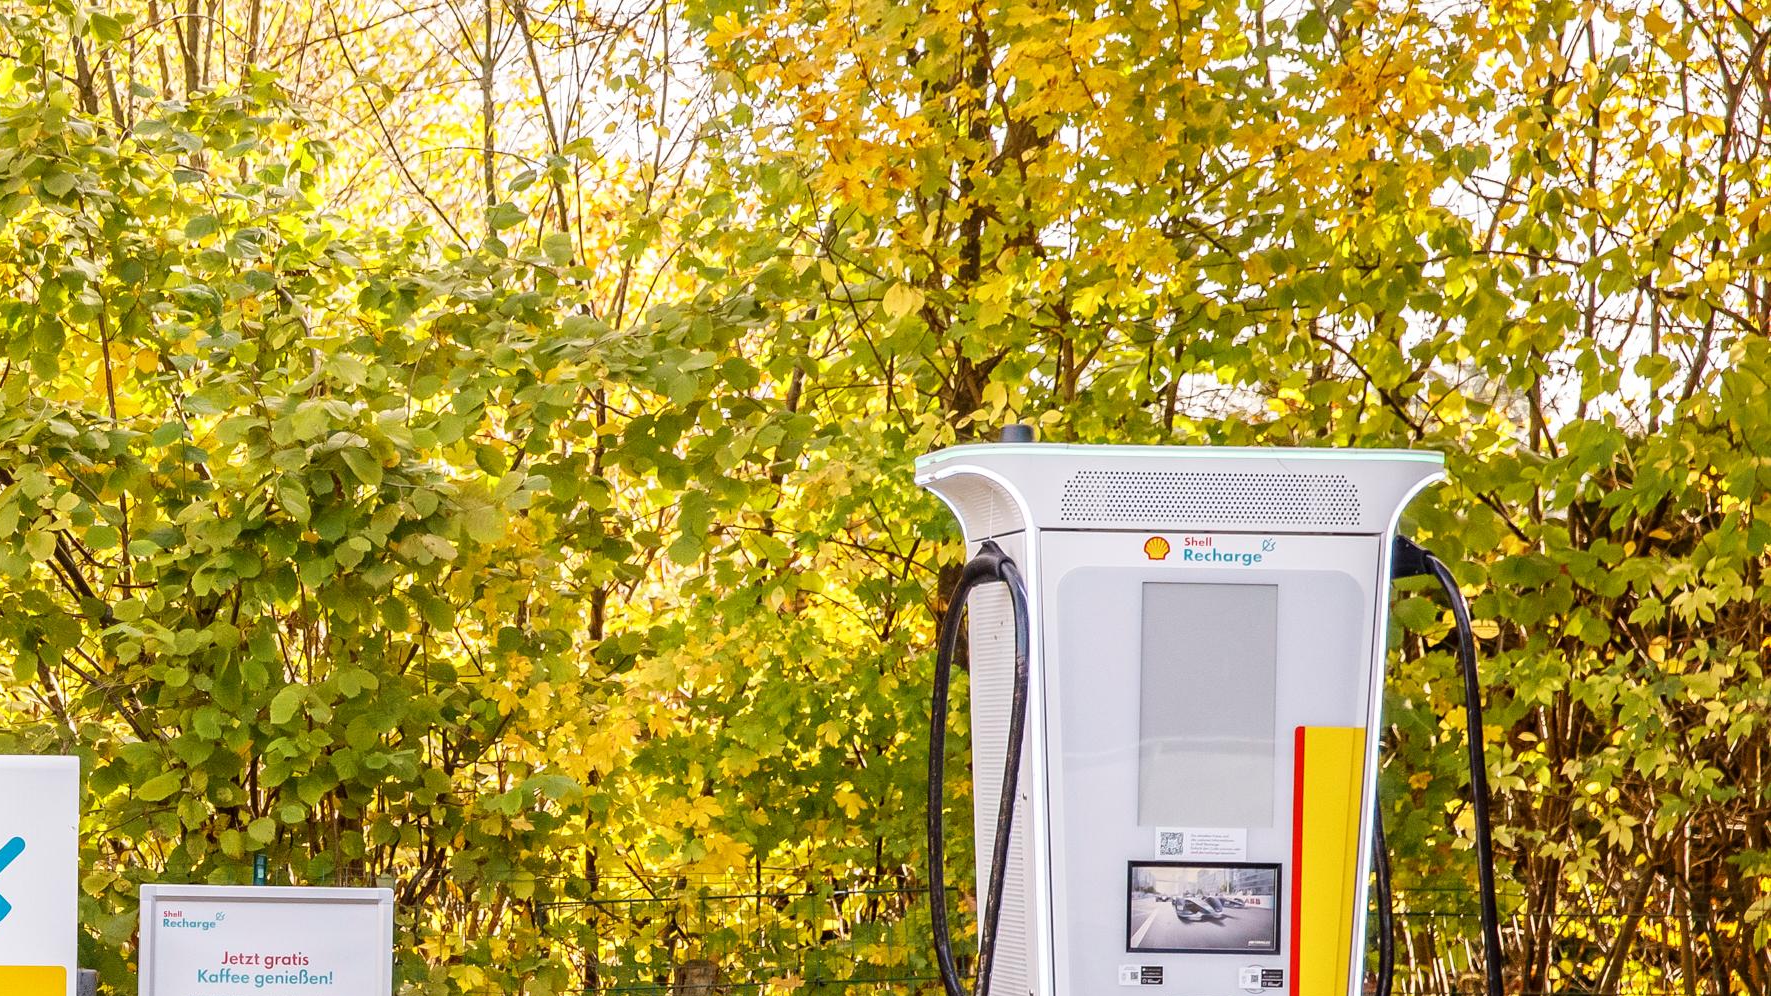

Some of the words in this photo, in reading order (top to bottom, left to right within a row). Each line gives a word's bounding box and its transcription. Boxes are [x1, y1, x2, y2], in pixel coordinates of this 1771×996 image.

[1184, 537, 1213, 547] Shell
[1184, 548, 1263, 566] Recharge
[163, 910, 183, 918] Shell
[163, 918, 216, 931] Recharge
[221, 951, 260, 965] Jetzt
[264, 951, 309, 970] gratis
[197, 968, 250, 983] Kaffee
[254, 968, 333, 988] genießen!
